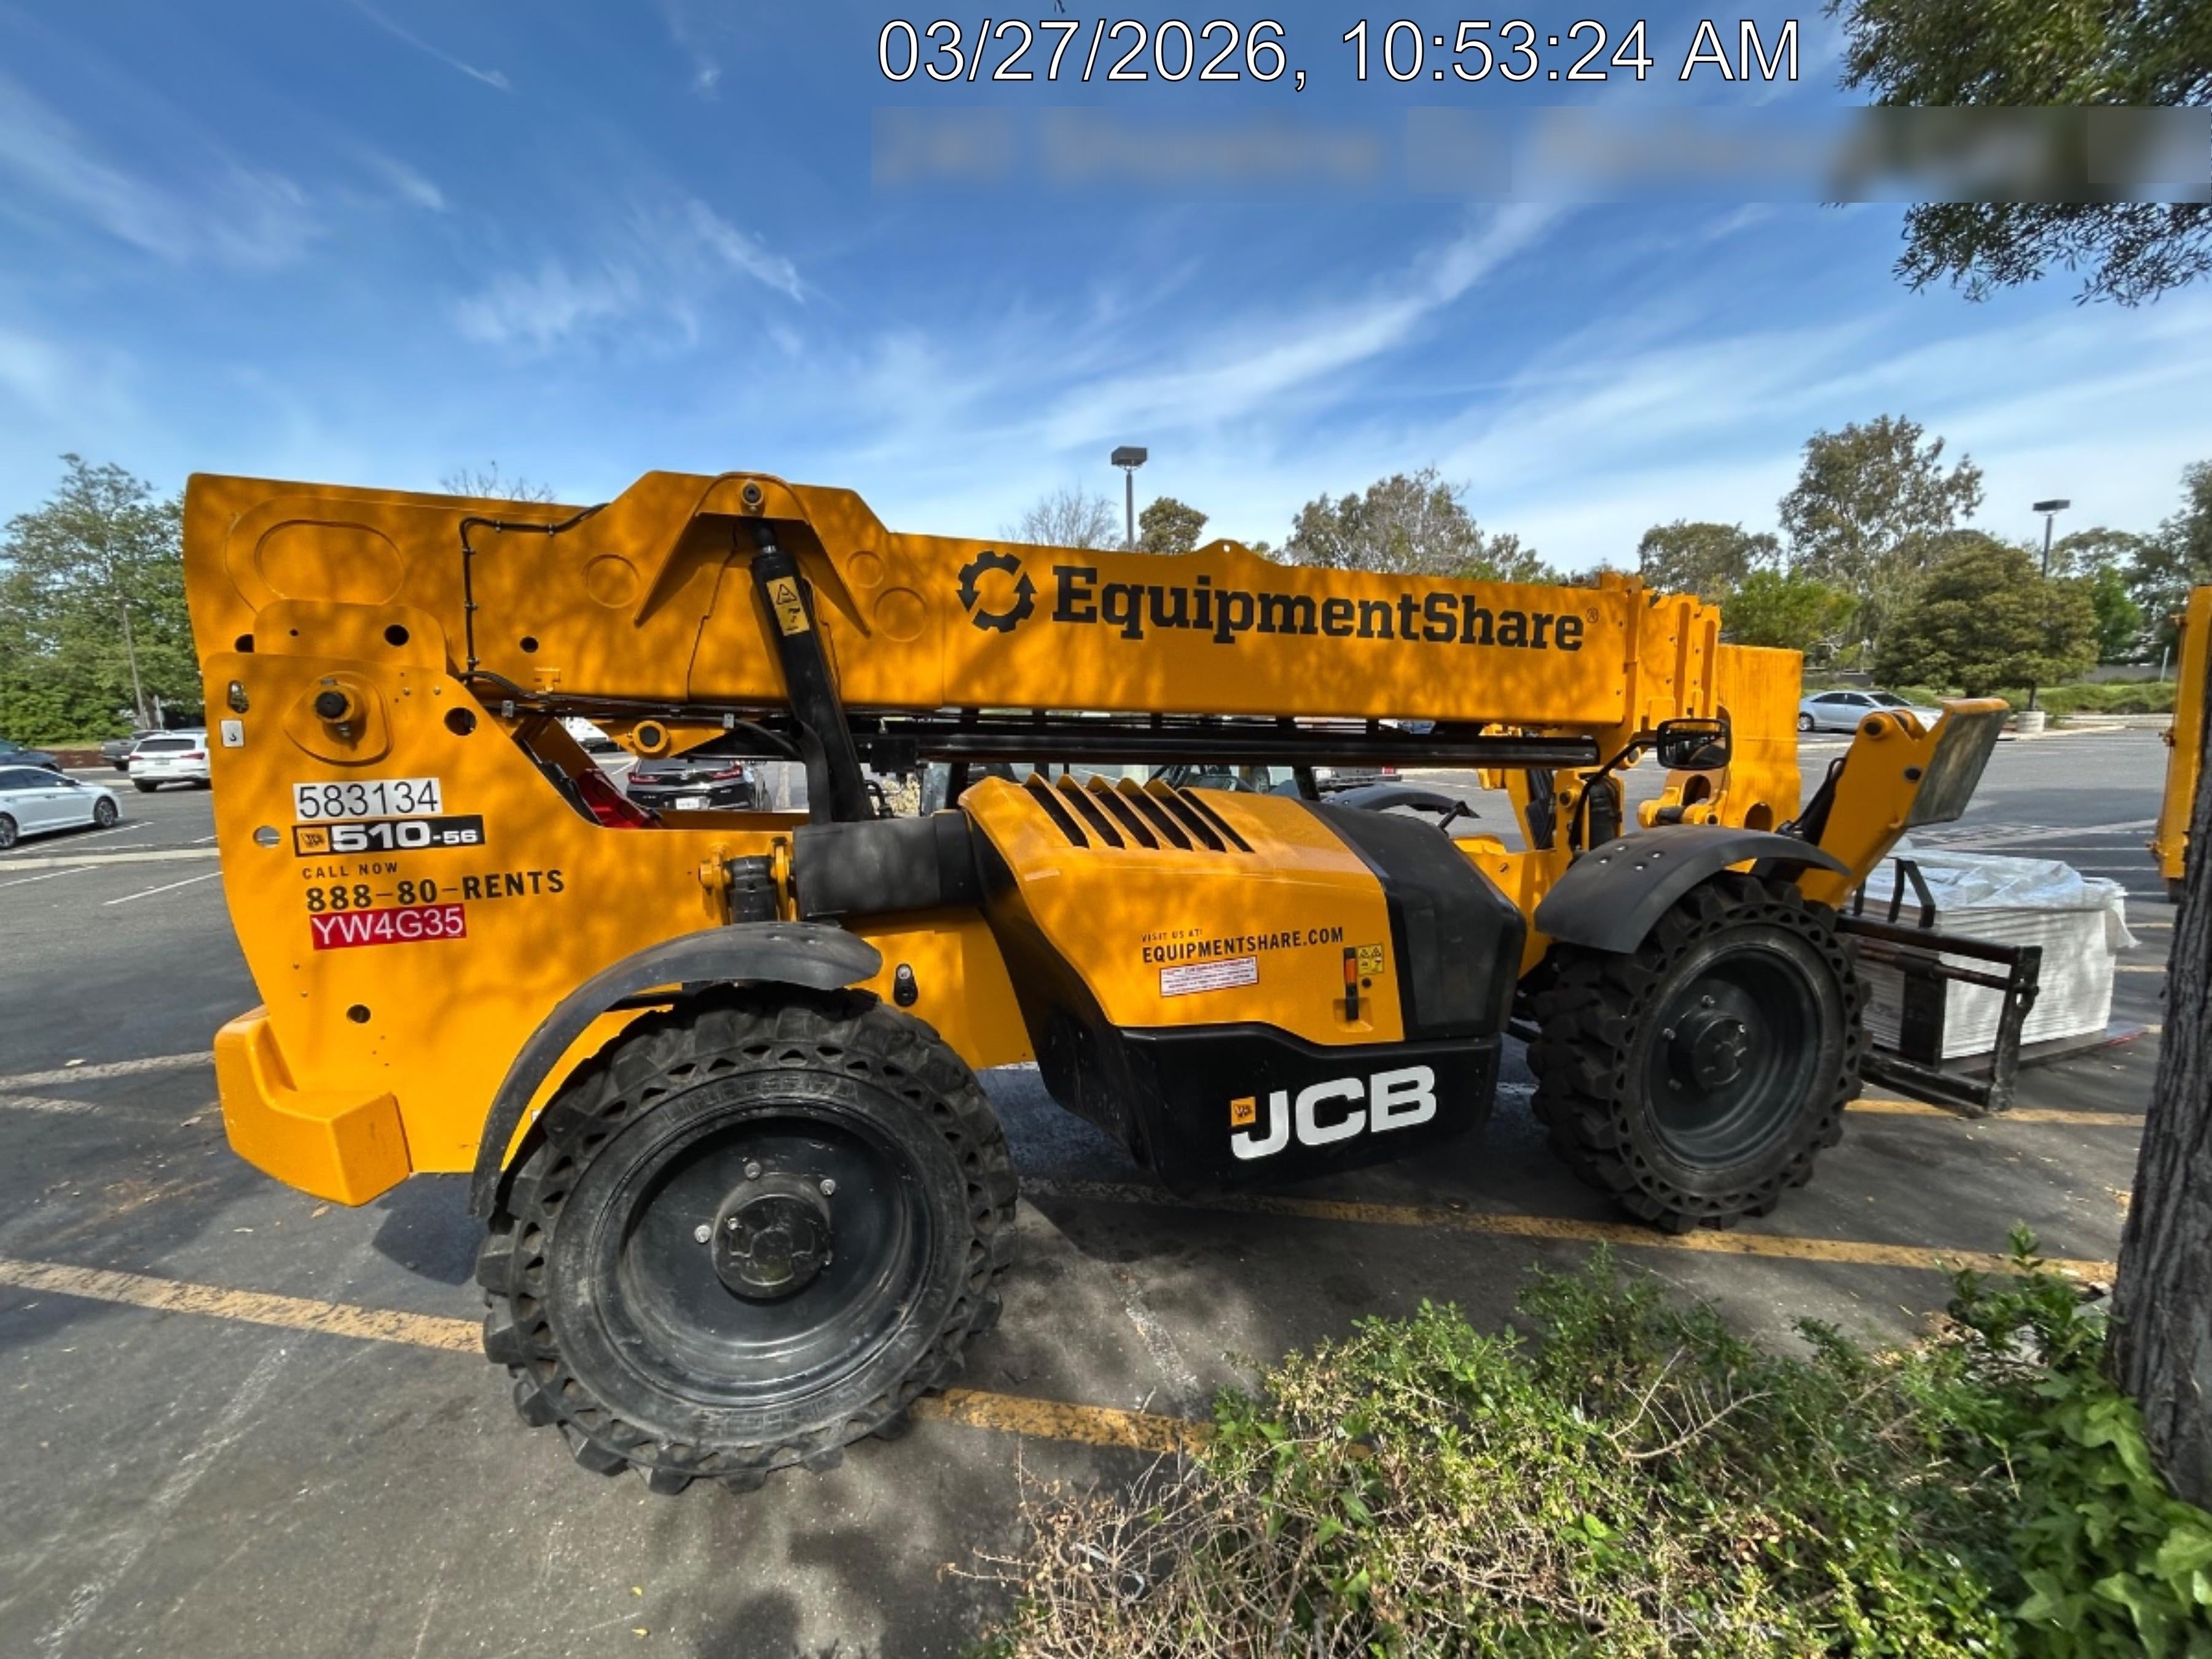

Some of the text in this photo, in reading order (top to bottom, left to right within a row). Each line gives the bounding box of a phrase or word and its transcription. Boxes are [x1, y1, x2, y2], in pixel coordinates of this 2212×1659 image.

[299, 780, 437, 818] 583134
[302, 861, 398, 880] CALL NOW
[307, 869, 564, 912] 888-80-RENTS
[312, 907, 463, 945] YW4G35
[1141, 931, 1167, 943] VISIT
[1172, 930, 1184, 939] US
[1143, 927, 1343, 963] EQUIPMENTSHARE.COM
[1231, 1065, 1437, 1160] JCB
